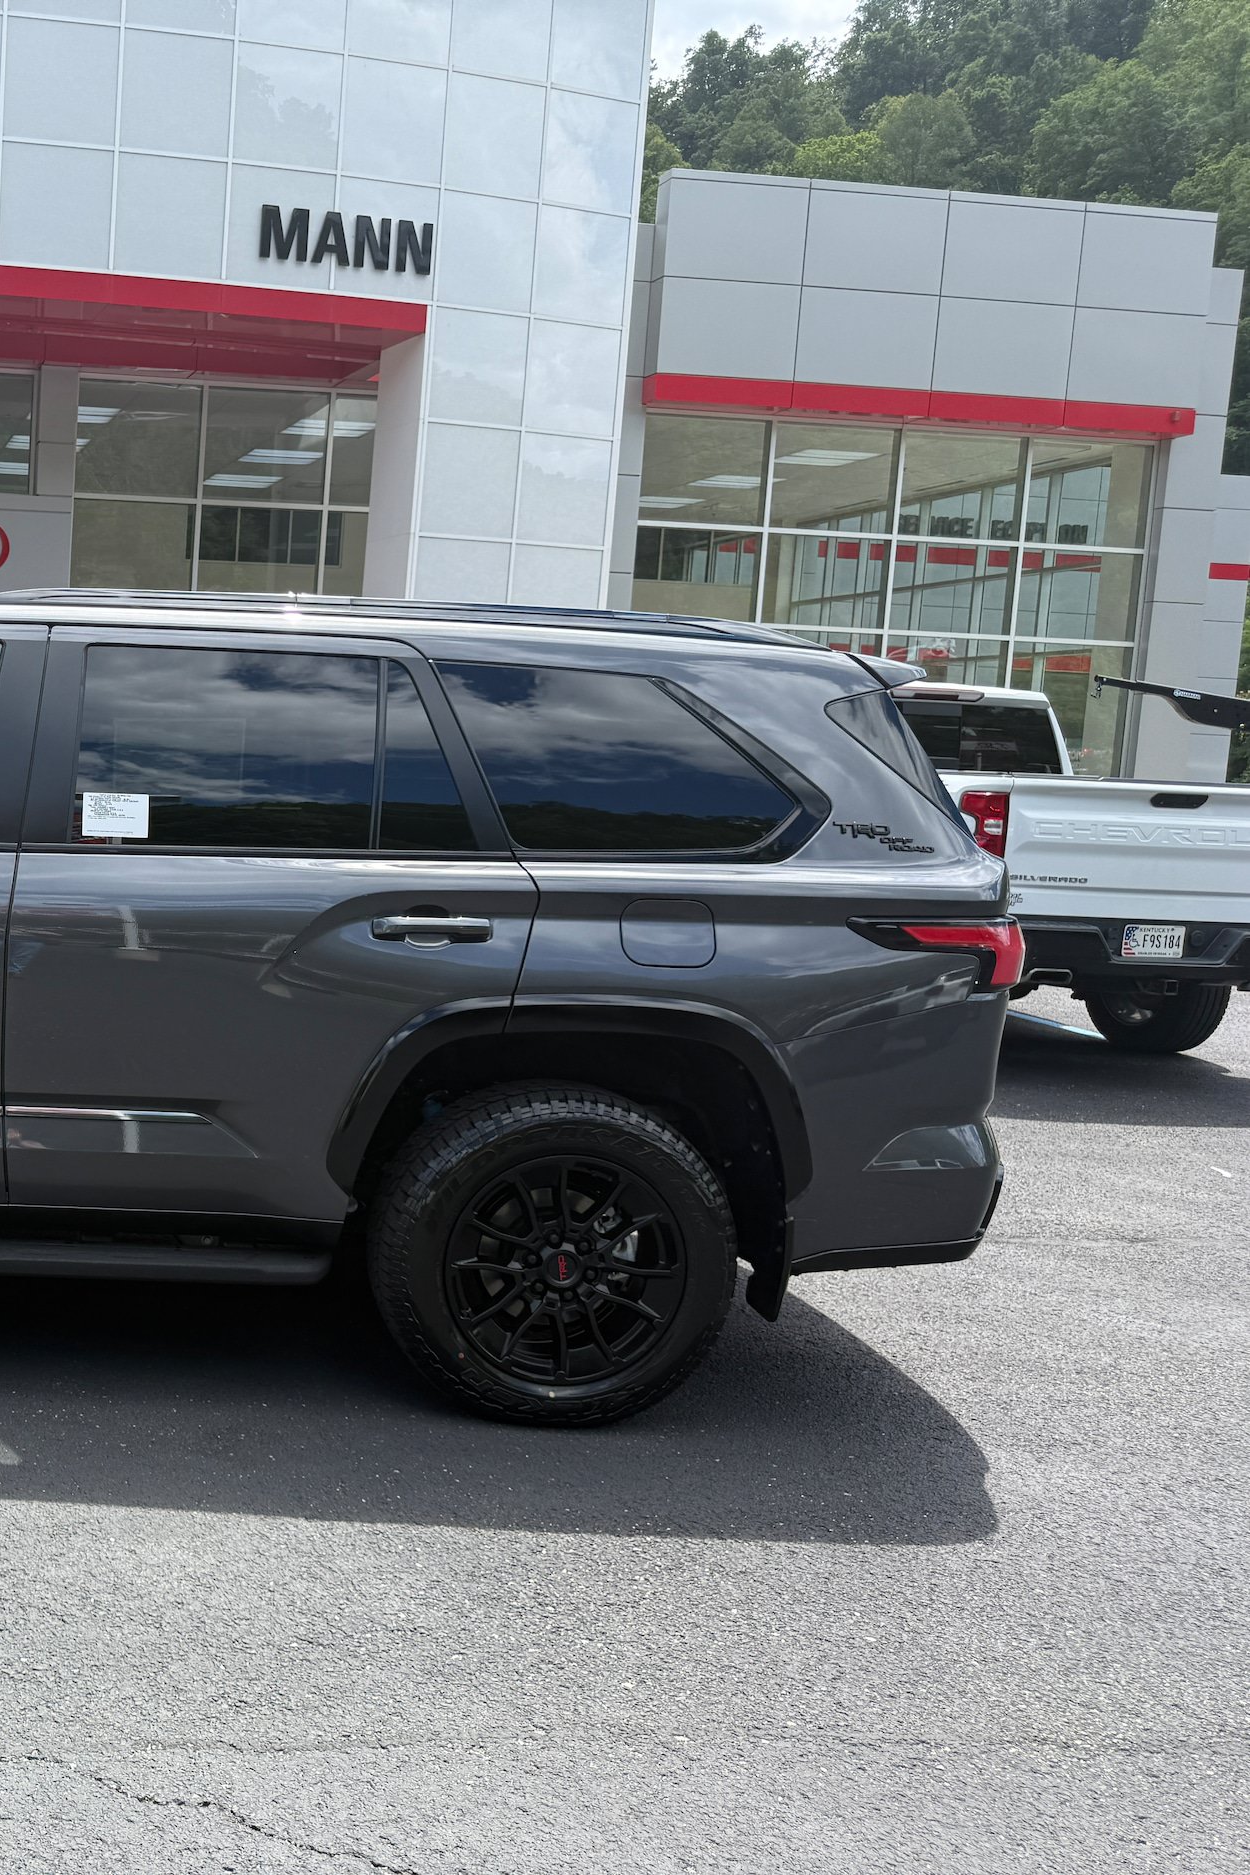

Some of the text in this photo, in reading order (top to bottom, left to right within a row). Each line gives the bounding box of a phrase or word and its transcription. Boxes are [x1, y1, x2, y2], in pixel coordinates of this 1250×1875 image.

[259, 204, 433, 275] MANN
[832, 821, 891, 839] TRD
[879, 837, 913, 845] OFF
[888, 844, 934, 854] ROAD
[1010, 874, 1088, 884] SILVERADO
[1142, 934, 1181, 949] F9S184
[557, 1255, 567, 1280] TRD
